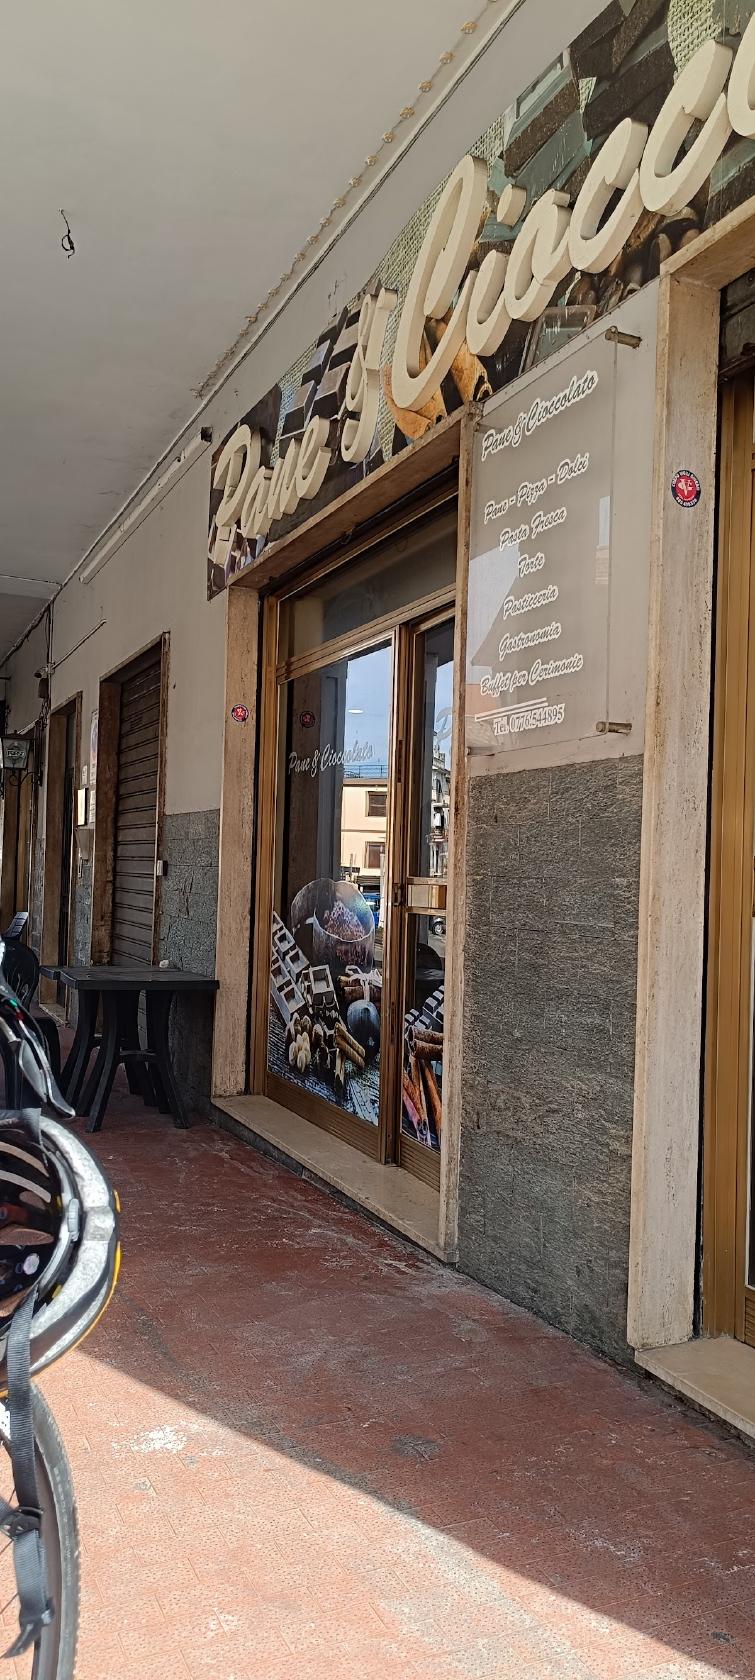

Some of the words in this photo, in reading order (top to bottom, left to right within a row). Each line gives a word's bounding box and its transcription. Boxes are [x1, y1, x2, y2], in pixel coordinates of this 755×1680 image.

[211, 415, 332, 567] Pane
[341, 287, 398, 463] &
[482, 426, 513, 461] Pane
[511, 411, 528, 448] &
[526, 370, 599, 435] Cioccolato
[485, 500, 509, 524] Pane
[517, 478, 548, 507] Pizza
[558, 453, 590, 484] Dolci
[499, 524, 530, 552] Pasta
[531, 507, 568, 539] Fresca
[519, 552, 545, 577] Torte
[503, 585, 559, 619] Pasticceria
[499, 622, 562, 662] Gastronomia
[480, 671, 511, 698] Buffet
[508, 669, 529, 693] per
[528, 653, 584, 685] Cerimonie
[288, 751, 311, 775] Pane
[310, 748, 321, 778] &
